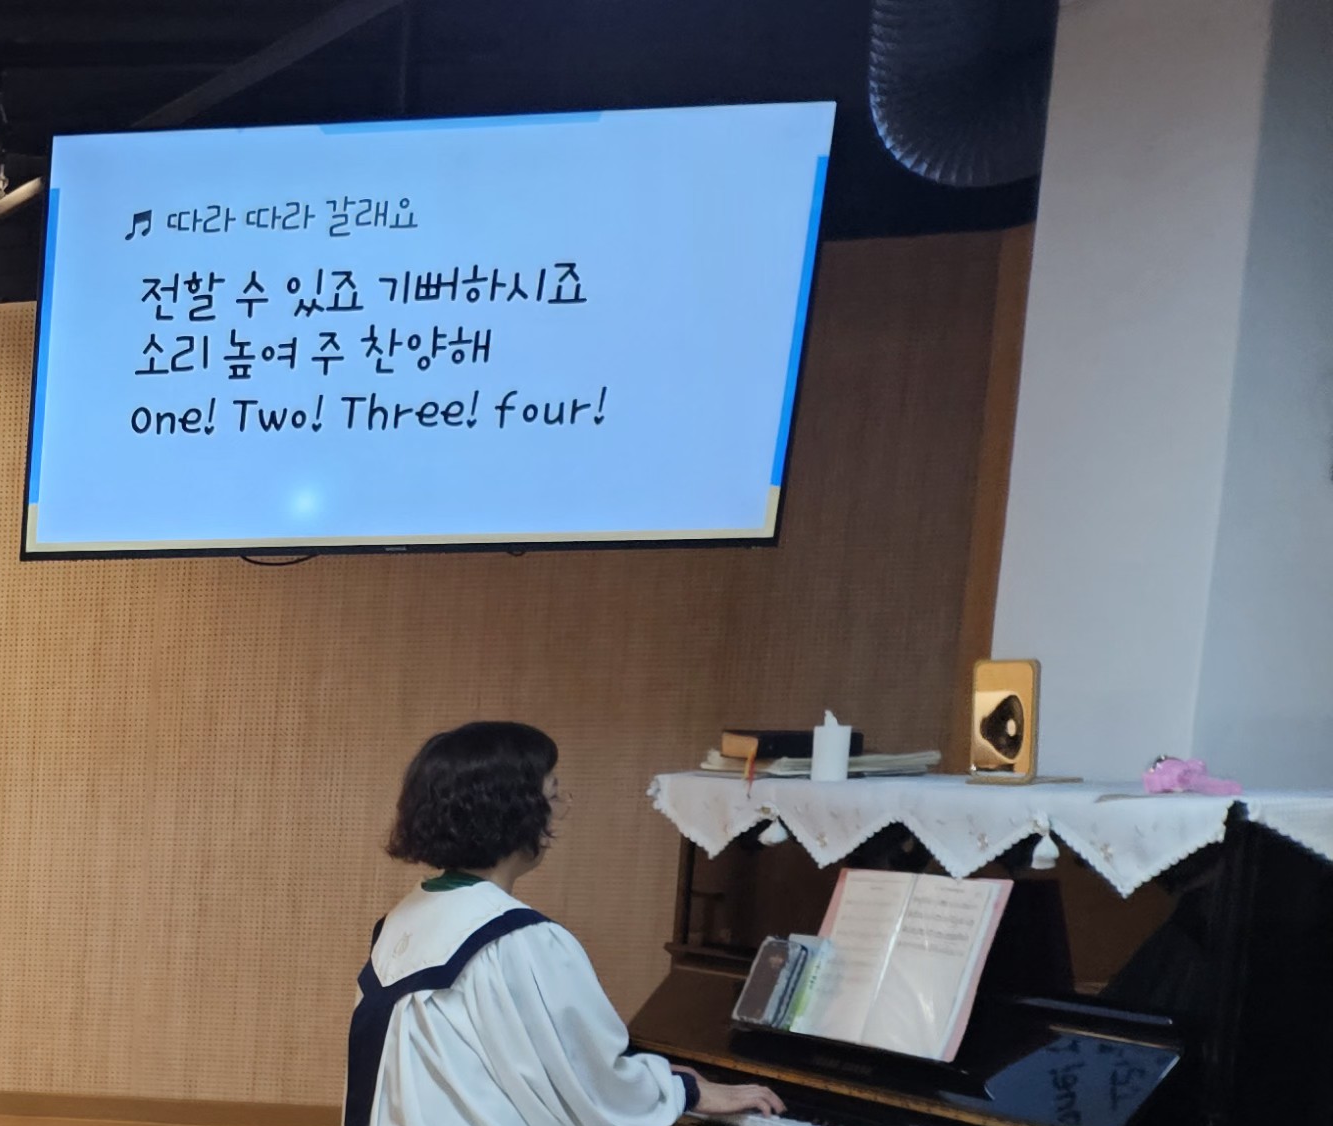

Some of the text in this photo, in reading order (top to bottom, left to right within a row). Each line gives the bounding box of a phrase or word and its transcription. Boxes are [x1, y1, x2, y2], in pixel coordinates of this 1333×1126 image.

[166, 195, 419, 238] 따라 따라 갈래요
[140, 262, 588, 322] 전할 수 있죠 기뻐하시죠
[134, 323, 492, 380] 소리 높여 주 찬양해
[232, 394, 324, 433] Two!
[340, 389, 480, 431] Three!
